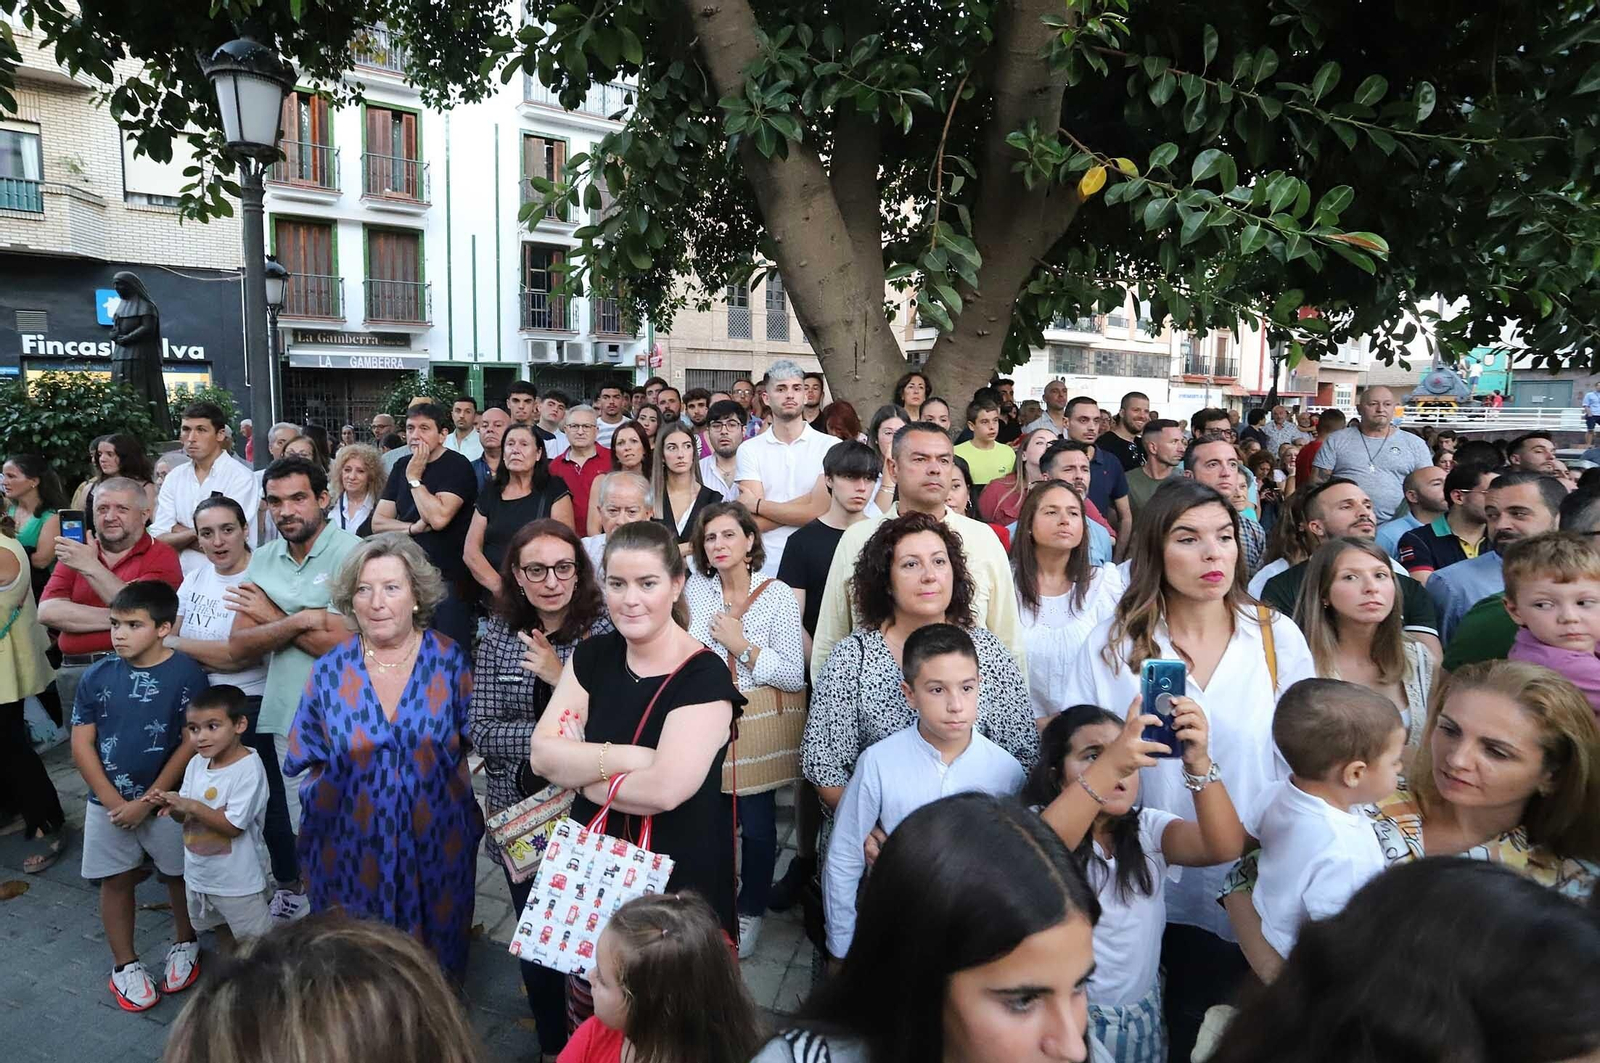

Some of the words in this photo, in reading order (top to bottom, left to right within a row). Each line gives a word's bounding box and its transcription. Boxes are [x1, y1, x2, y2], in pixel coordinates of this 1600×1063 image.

[297, 331, 313, 343] La
[317, 332, 379, 345] Gamberra
[21, 334, 112, 357] Fincas
[318, 355, 333, 368] LA
[349, 356, 405, 369] GAMBERRA
